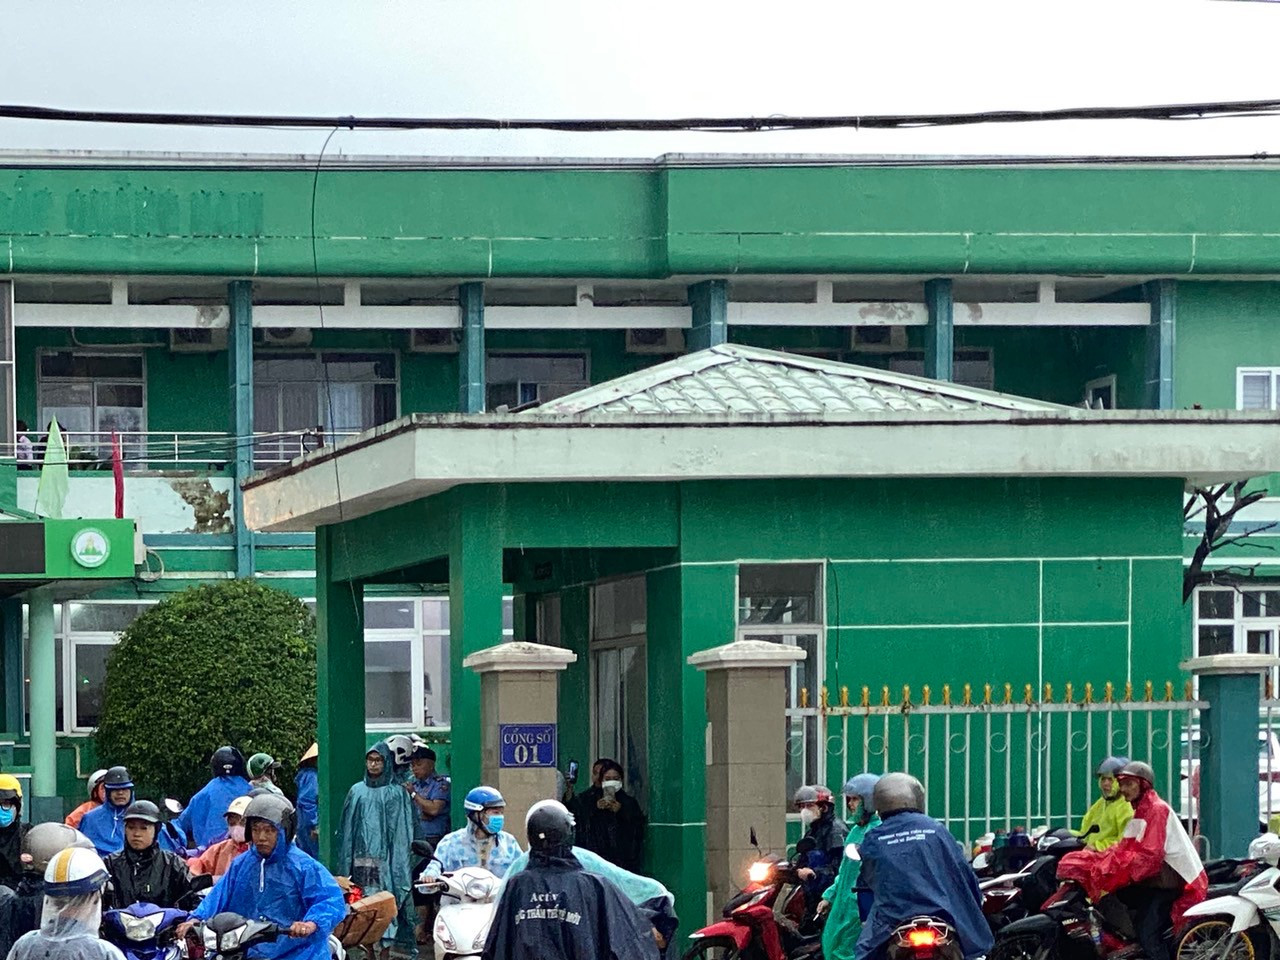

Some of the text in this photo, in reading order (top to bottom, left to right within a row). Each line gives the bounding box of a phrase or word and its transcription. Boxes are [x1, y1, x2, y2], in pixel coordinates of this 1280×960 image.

[504, 728, 552, 744] CỔNG SỐ
[514, 744, 540, 764] 01
